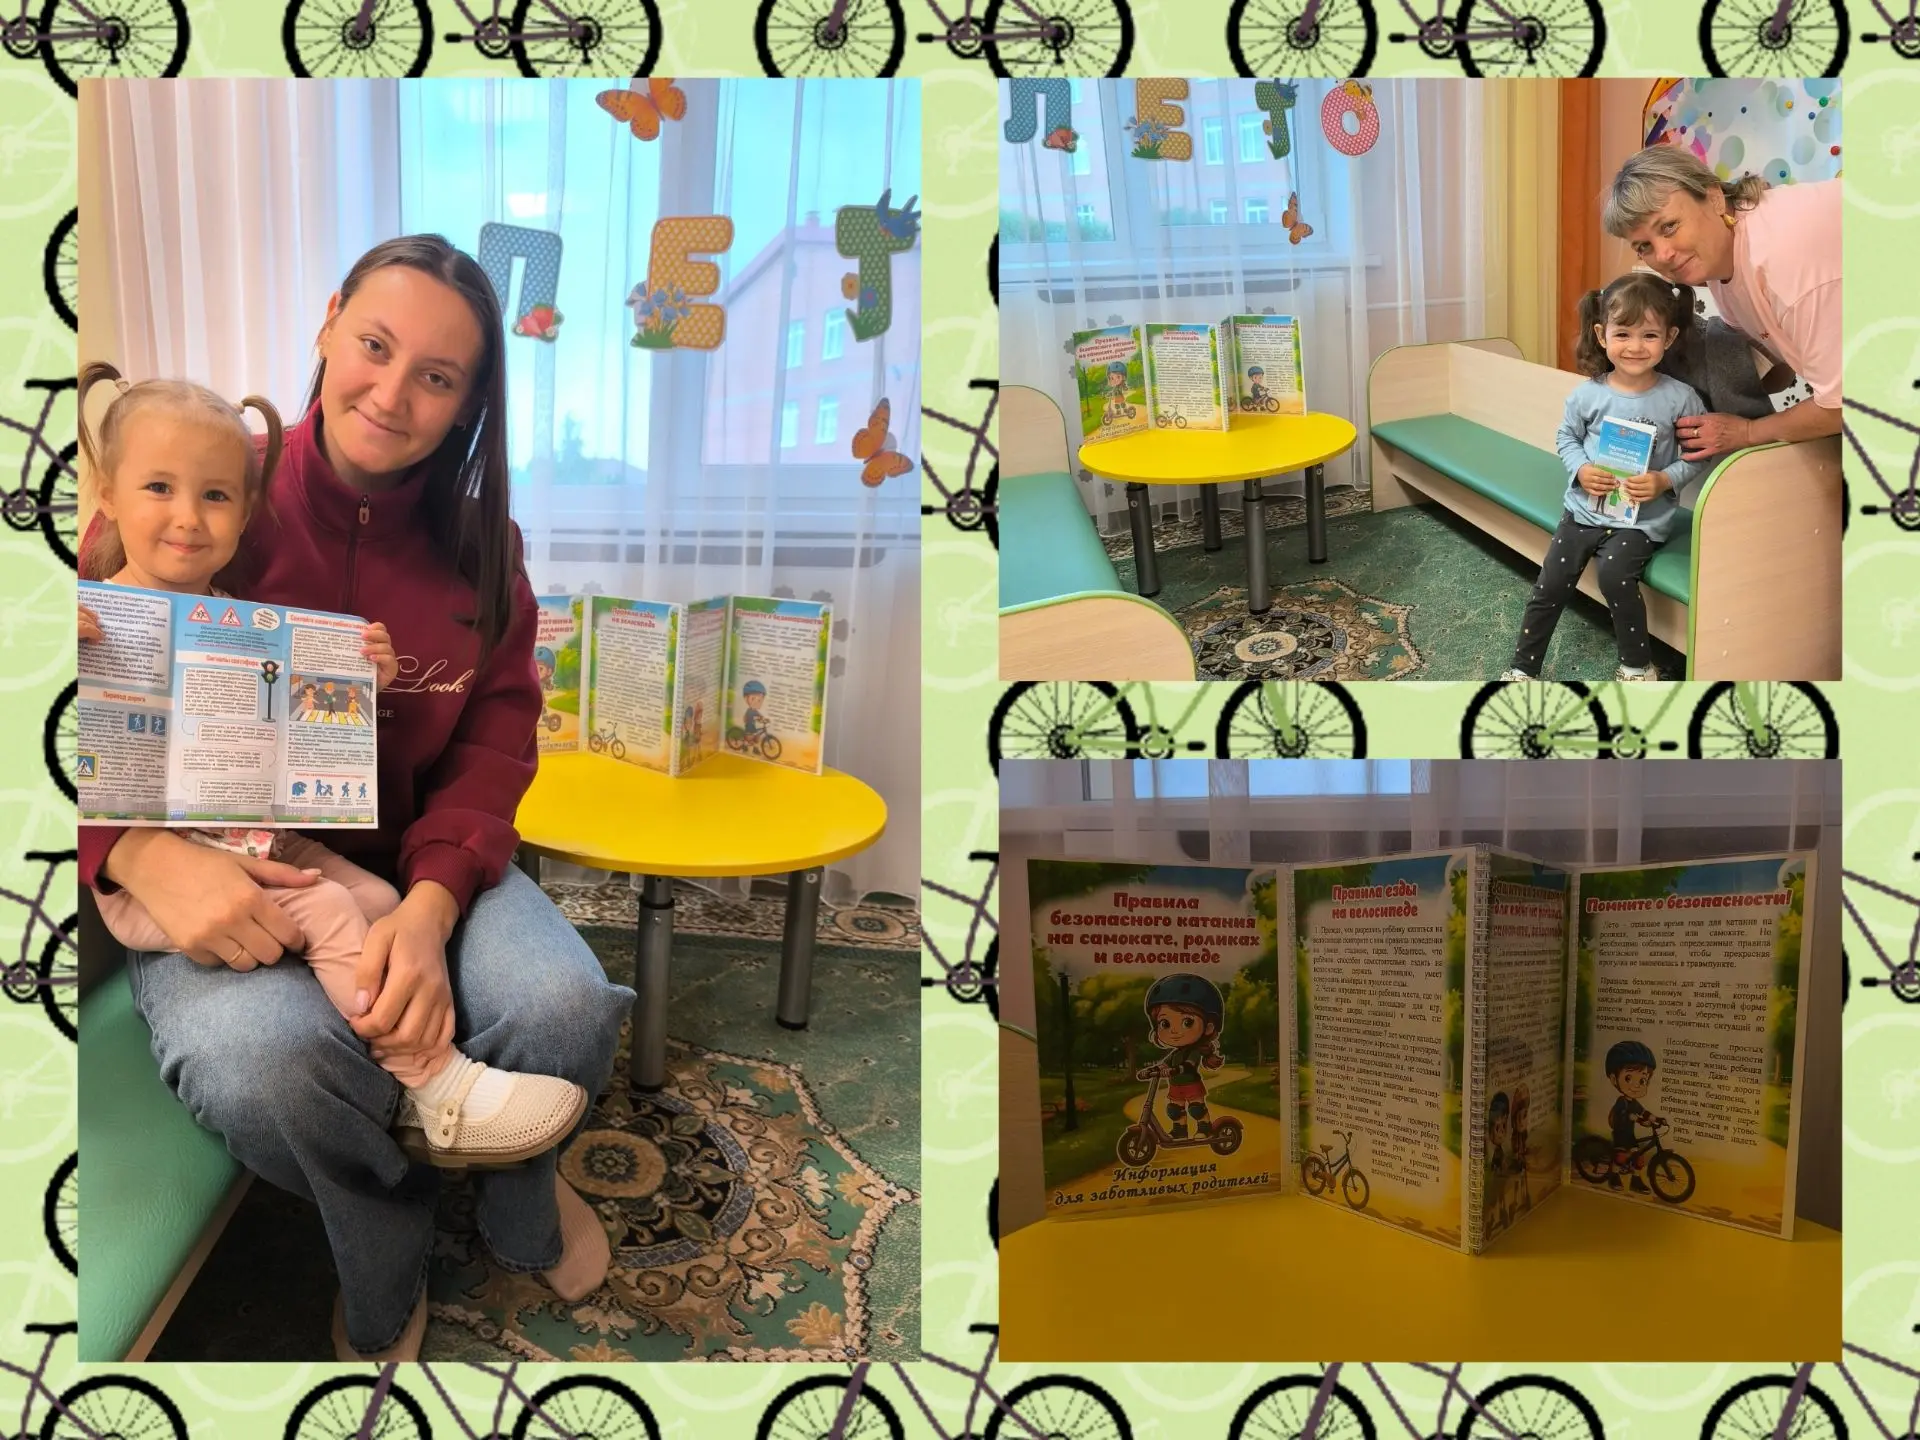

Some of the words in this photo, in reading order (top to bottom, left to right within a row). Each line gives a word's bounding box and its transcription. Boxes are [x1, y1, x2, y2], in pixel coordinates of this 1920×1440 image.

[383, 655, 474, 693] Look
[1333, 886, 1382, 904] Правила
[1386, 880, 1416, 897] езды
[1587, 899, 1651, 911] Помните
[1656, 900, 1663, 909] о
[1667, 890, 1792, 909] безопасности!
[1114, 893, 1200, 911] Правила
[1332, 909, 1346, 919] на
[1350, 901, 1418, 918] велосипеде
[1051, 910, 1172, 927] безопасного
[1177, 916, 1256, 929] катания
[1048, 933, 1073, 945] на
[1080, 934, 1178, 946] самокате,
[1184, 934, 1260, 949] роликах
[1094, 952, 1107, 963] и
[1113, 949, 1221, 964] велосипеде
[1113, 1163, 1217, 1183] Информация
[1055, 1191, 1083, 1205] для
[1091, 1182, 1187, 1202] заботливых
[1192, 1172, 1269, 1195] родителей
